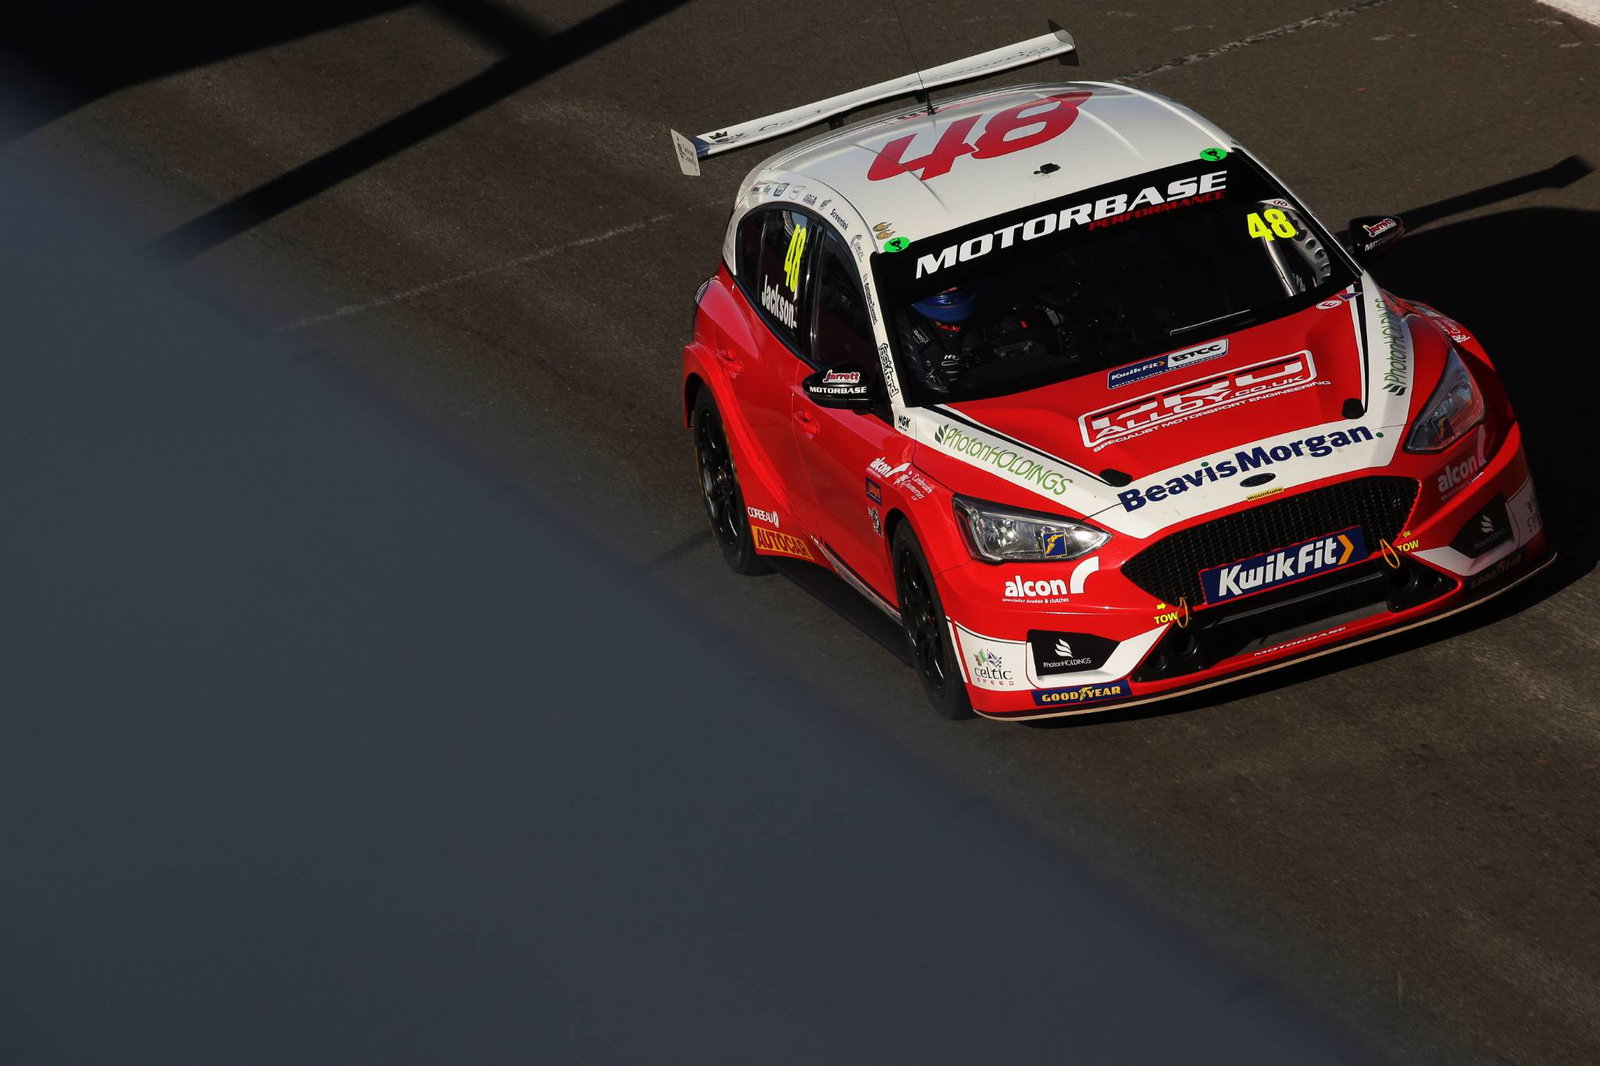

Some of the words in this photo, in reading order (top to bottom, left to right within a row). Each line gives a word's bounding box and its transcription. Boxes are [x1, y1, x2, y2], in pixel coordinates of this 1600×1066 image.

[867, 91, 1093, 181] 48
[1089, 190, 1226, 231] PERFORMANCE
[916, 170, 1227, 279] MOTORBASE
[1247, 208, 1296, 242] 48
[783, 224, 807, 293] 48
[1171, 344, 1222, 362] BTCC
[809, 386, 867, 395] MOTORBASE
[1093, 425, 1159, 452] SPECIALIST
[1161, 399, 1246, 428] MOTORSPORT
[1248, 380, 1332, 403] ENGINEERING
[870, 456, 892, 477] alcon
[943, 427, 1074, 496] PhotonHOLDINGS
[1438, 455, 1479, 493] alcon
[1247, 487, 1283, 500] mountune
[747, 506, 774, 523] CORBEAU
[757, 528, 812, 558] AUTOCAR
[1397, 540, 1420, 553] TOW
[1004, 575, 1068, 597] alcon
[1154, 611, 1178, 625] TOW
[1254, 627, 1347, 657] MOTORBASE
[974, 666, 1013, 680] celtic
[1043, 657, 1092, 669] PhotonHOLDINGS
[976, 677, 1015, 686] SPEED
